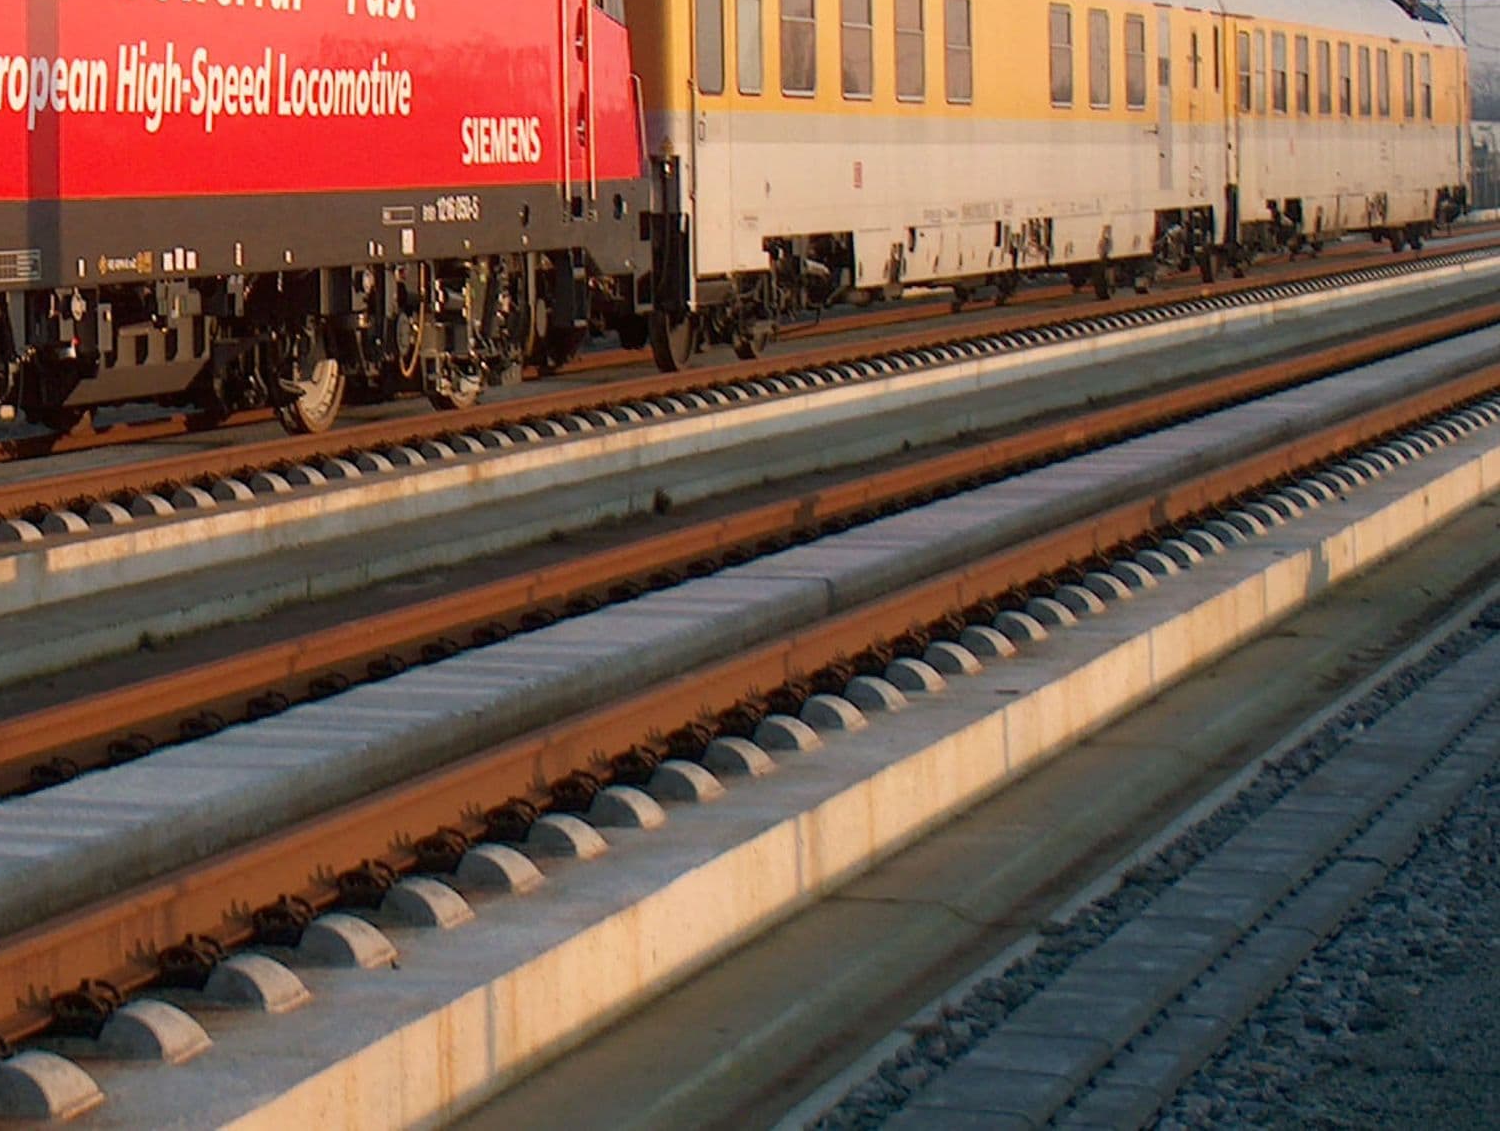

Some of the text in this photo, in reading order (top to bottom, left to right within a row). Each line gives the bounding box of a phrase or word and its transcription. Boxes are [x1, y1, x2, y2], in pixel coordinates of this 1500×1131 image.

[116, 40, 273, 133] High-Speed
[277, 51, 413, 117] Locomotive
[461, 116, 542, 165] SIEMENS
